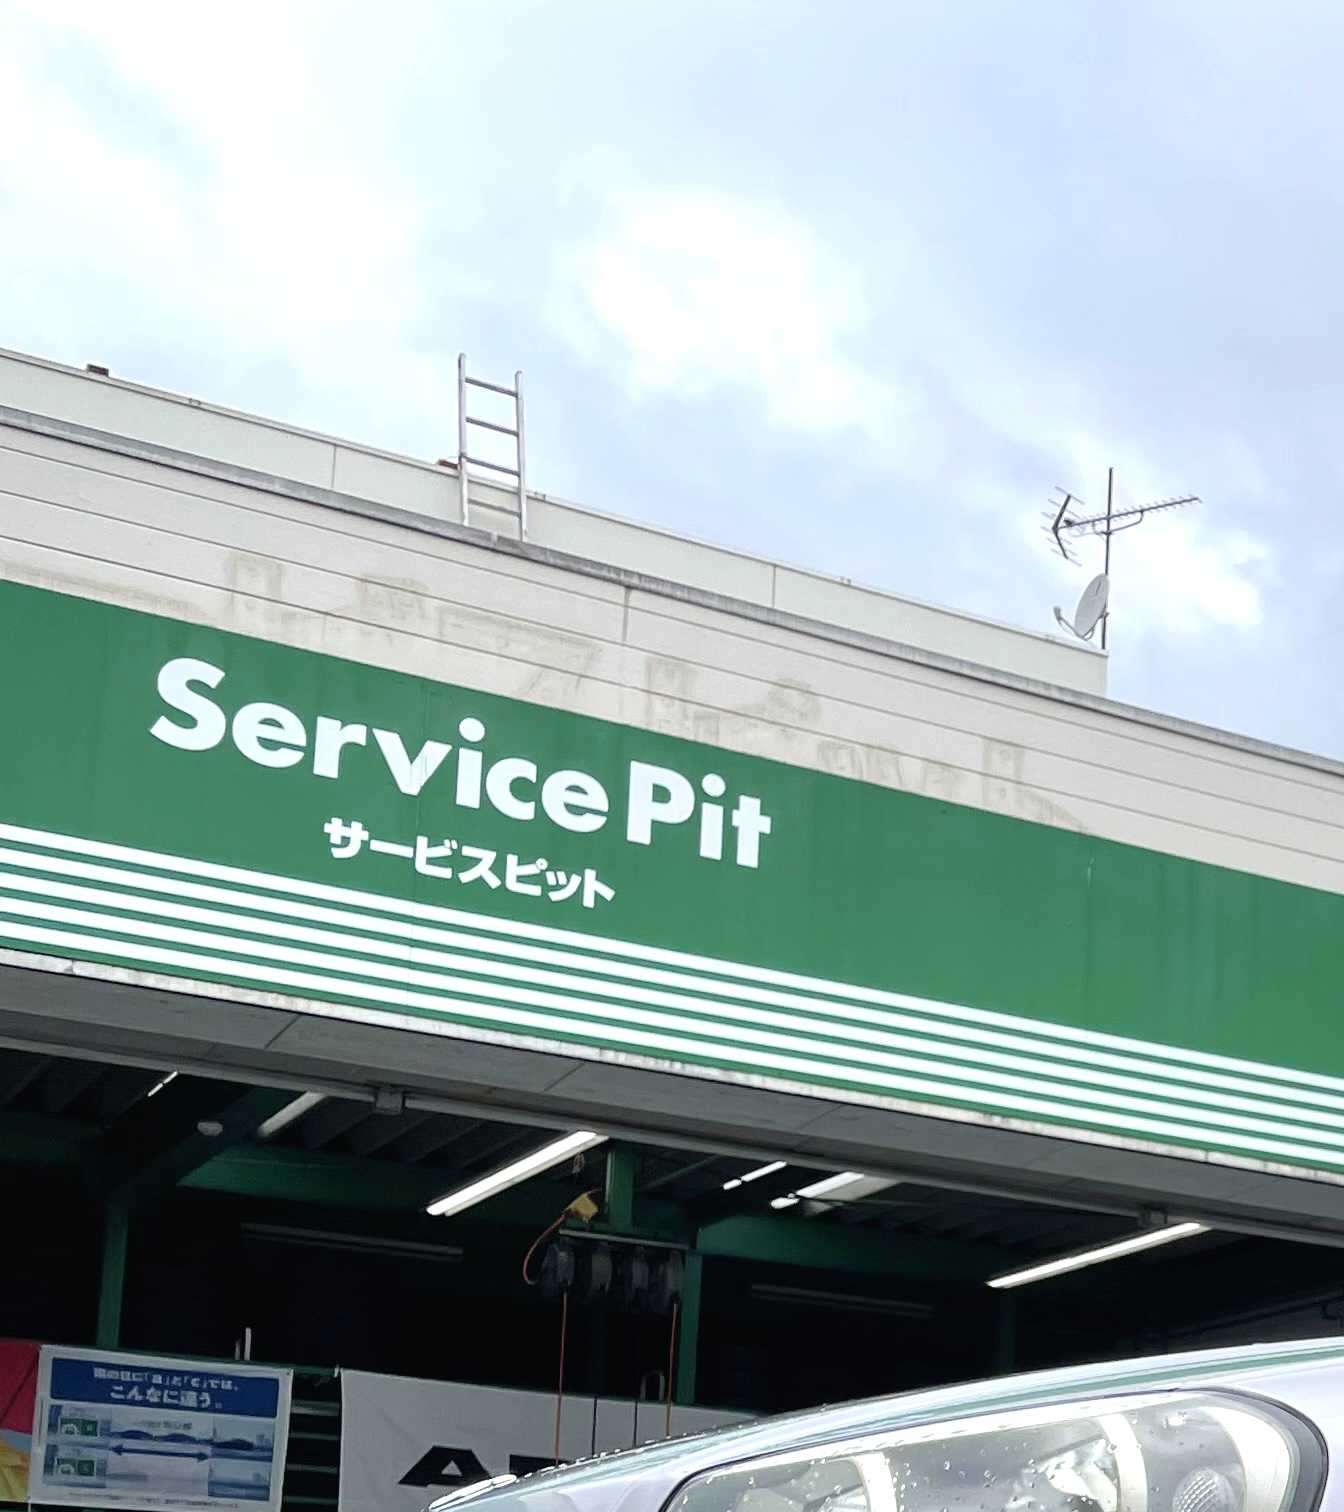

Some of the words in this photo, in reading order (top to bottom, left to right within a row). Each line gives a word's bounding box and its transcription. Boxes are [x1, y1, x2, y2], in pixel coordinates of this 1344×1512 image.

[148, 656, 609, 834] Service
[626, 759, 773, 869] Pit
[323, 816, 616, 909] サービスピット
